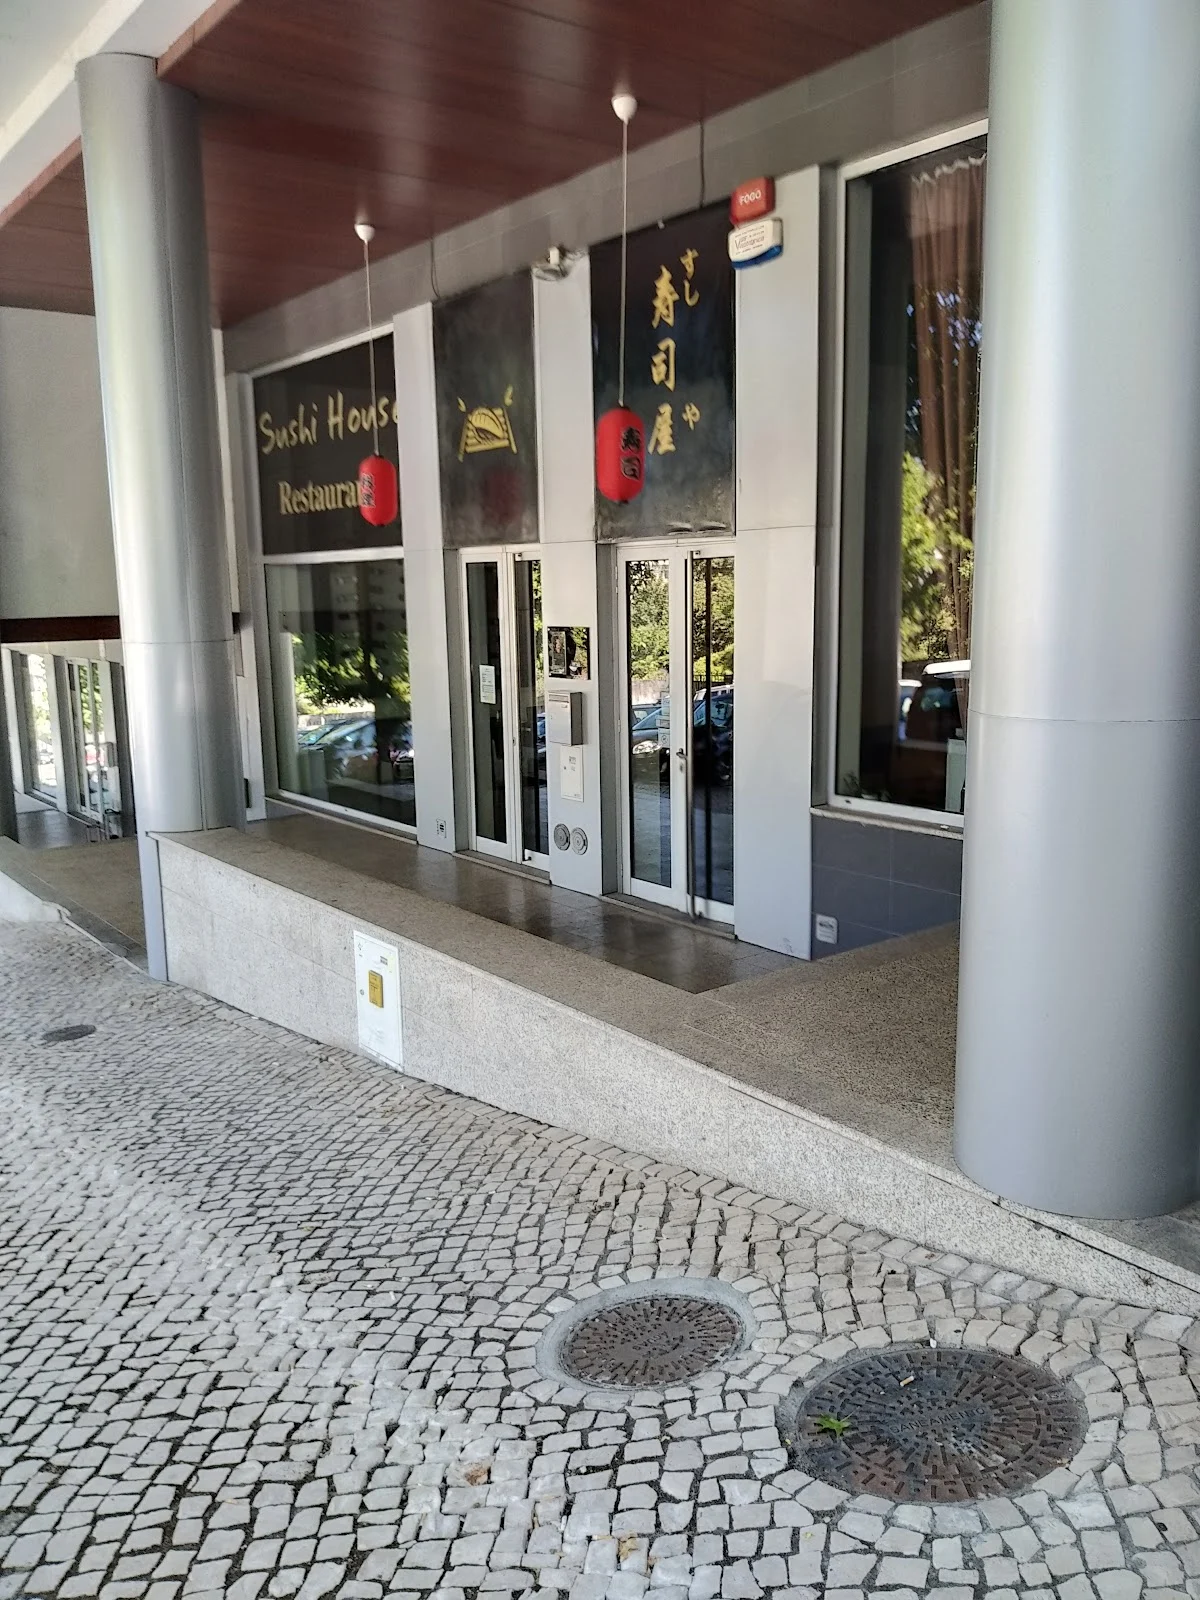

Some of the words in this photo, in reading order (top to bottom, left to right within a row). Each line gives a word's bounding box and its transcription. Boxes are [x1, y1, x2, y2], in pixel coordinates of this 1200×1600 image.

[739, 189, 762, 206] FOGO
[647, 264, 680, 456] 寿司屋
[259, 402, 319, 455] Sushi
[889, 1407, 985, 1434] SANEAMENTO
